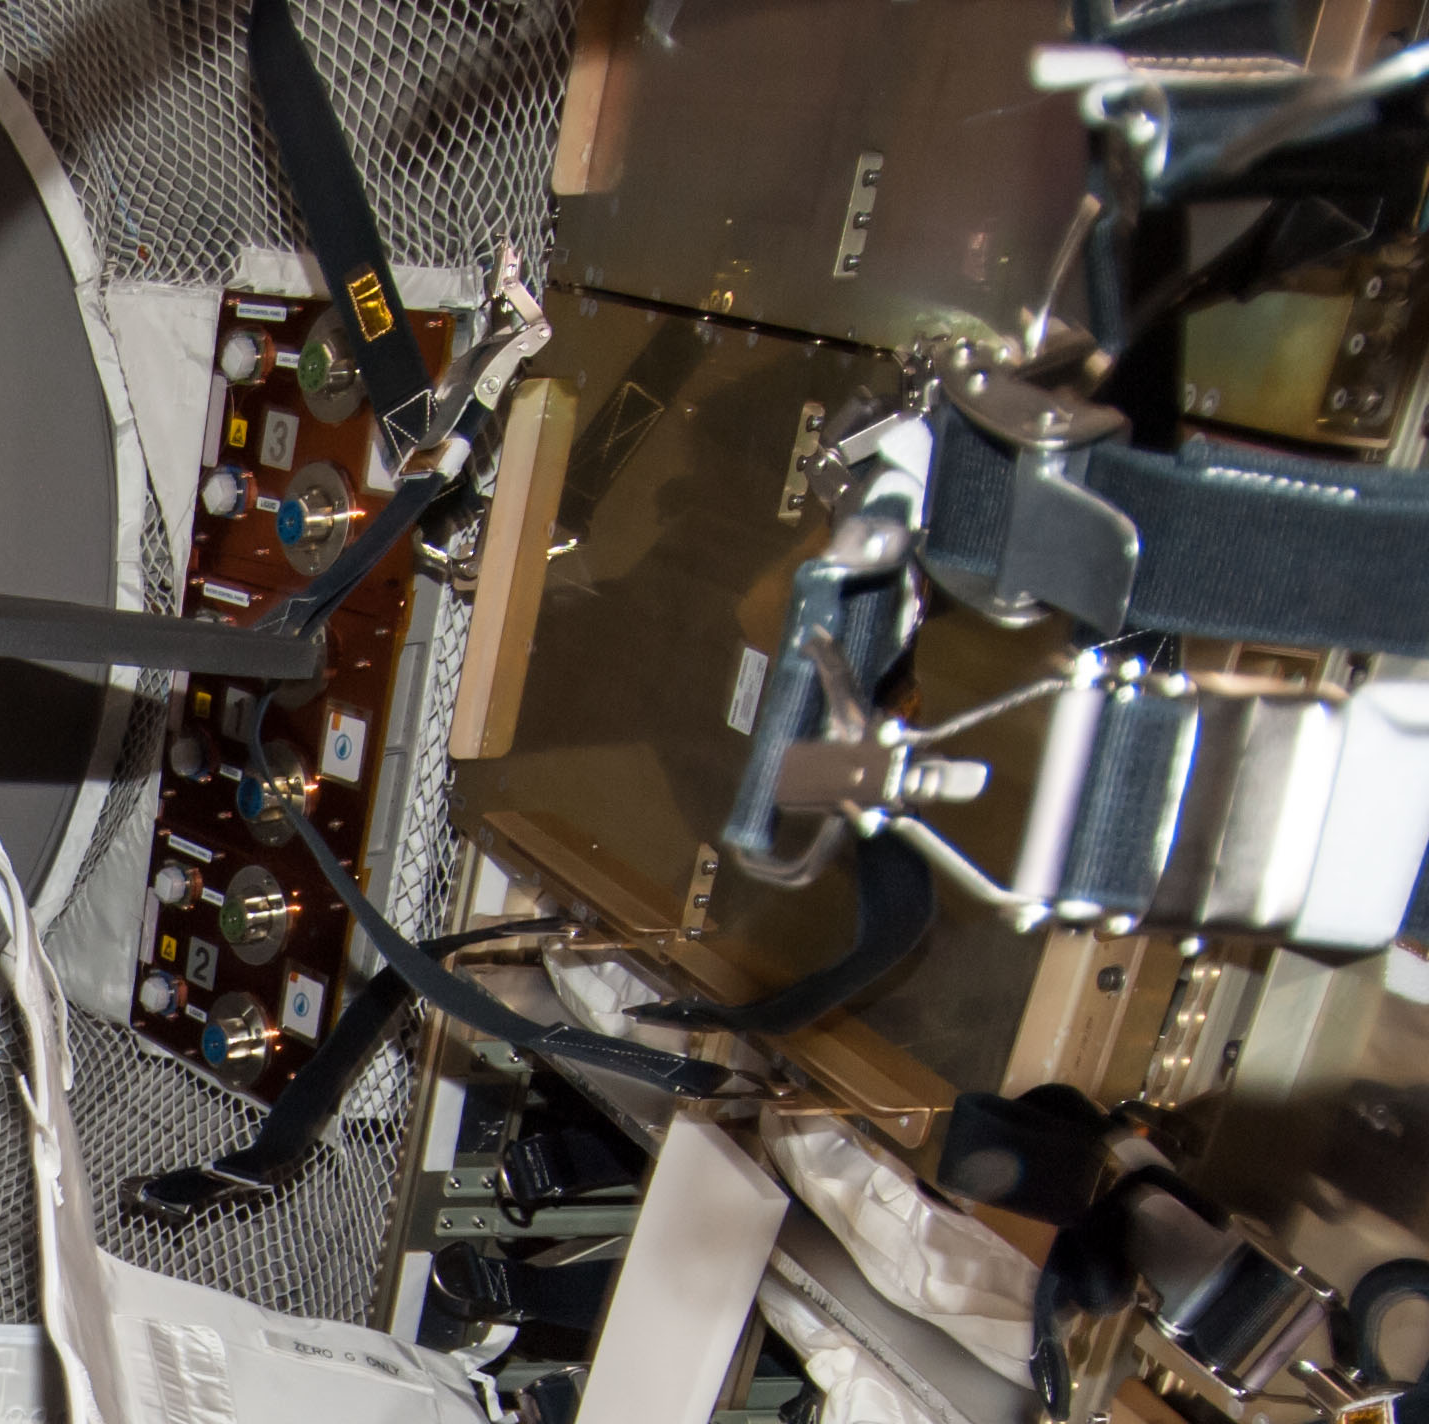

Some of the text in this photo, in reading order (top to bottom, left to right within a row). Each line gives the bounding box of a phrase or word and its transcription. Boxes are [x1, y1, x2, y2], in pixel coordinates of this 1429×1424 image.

[269, 420, 288, 462] 3
[192, 947, 210, 982] 2
[293, 1340, 400, 1376] ZERO G ONLY
